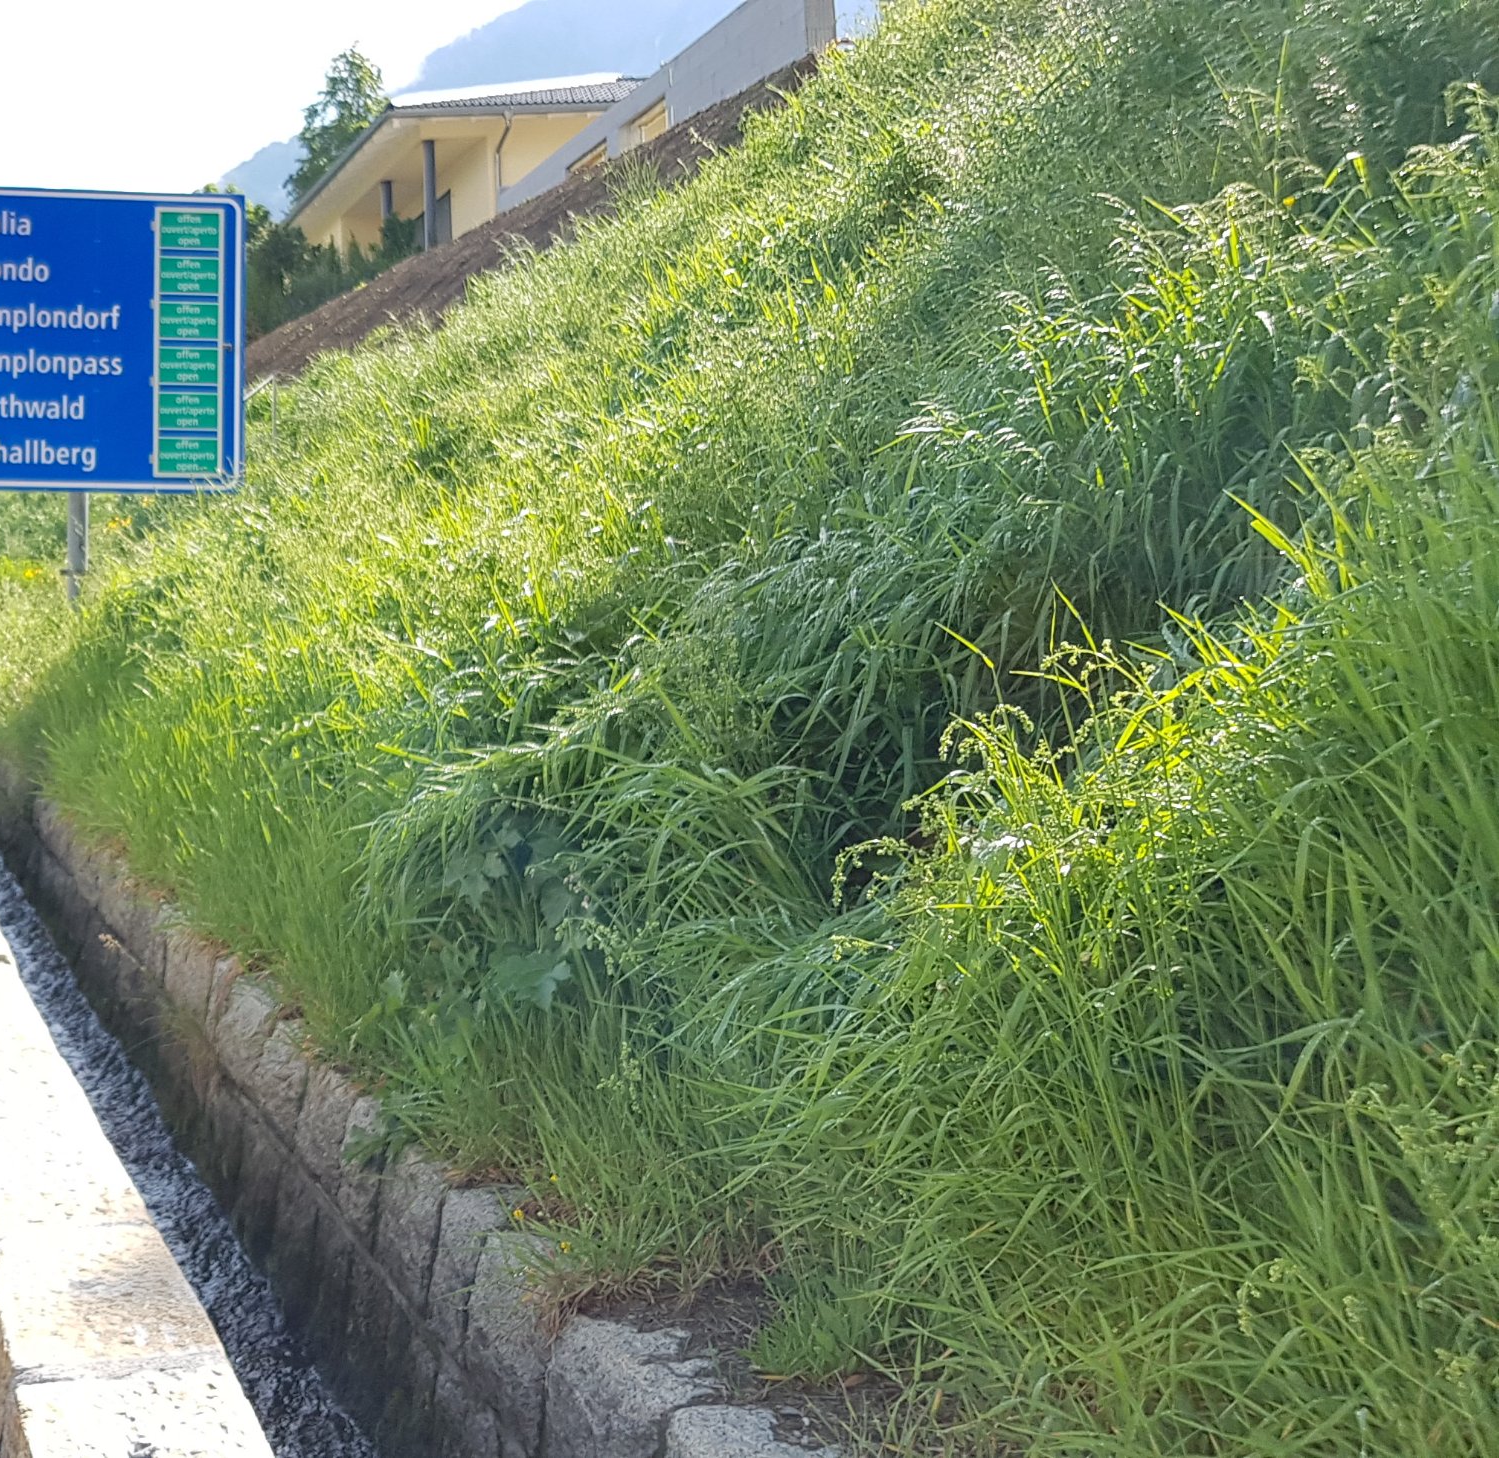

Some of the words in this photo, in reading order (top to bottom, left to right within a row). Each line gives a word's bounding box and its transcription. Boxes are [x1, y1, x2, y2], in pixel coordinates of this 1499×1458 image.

[177, 214, 200, 223] offen
[178, 238, 200, 247] open
[177, 260, 200, 268] offen
[178, 283, 200, 292] open
[176, 305, 200, 314] offen
[176, 328, 199, 337] open
[176, 350, 200, 359] offen
[176, 373, 199, 382] open
[176, 396, 200, 404] offen
[176, 418, 198, 428] open
[176, 441, 199, 449] offen
